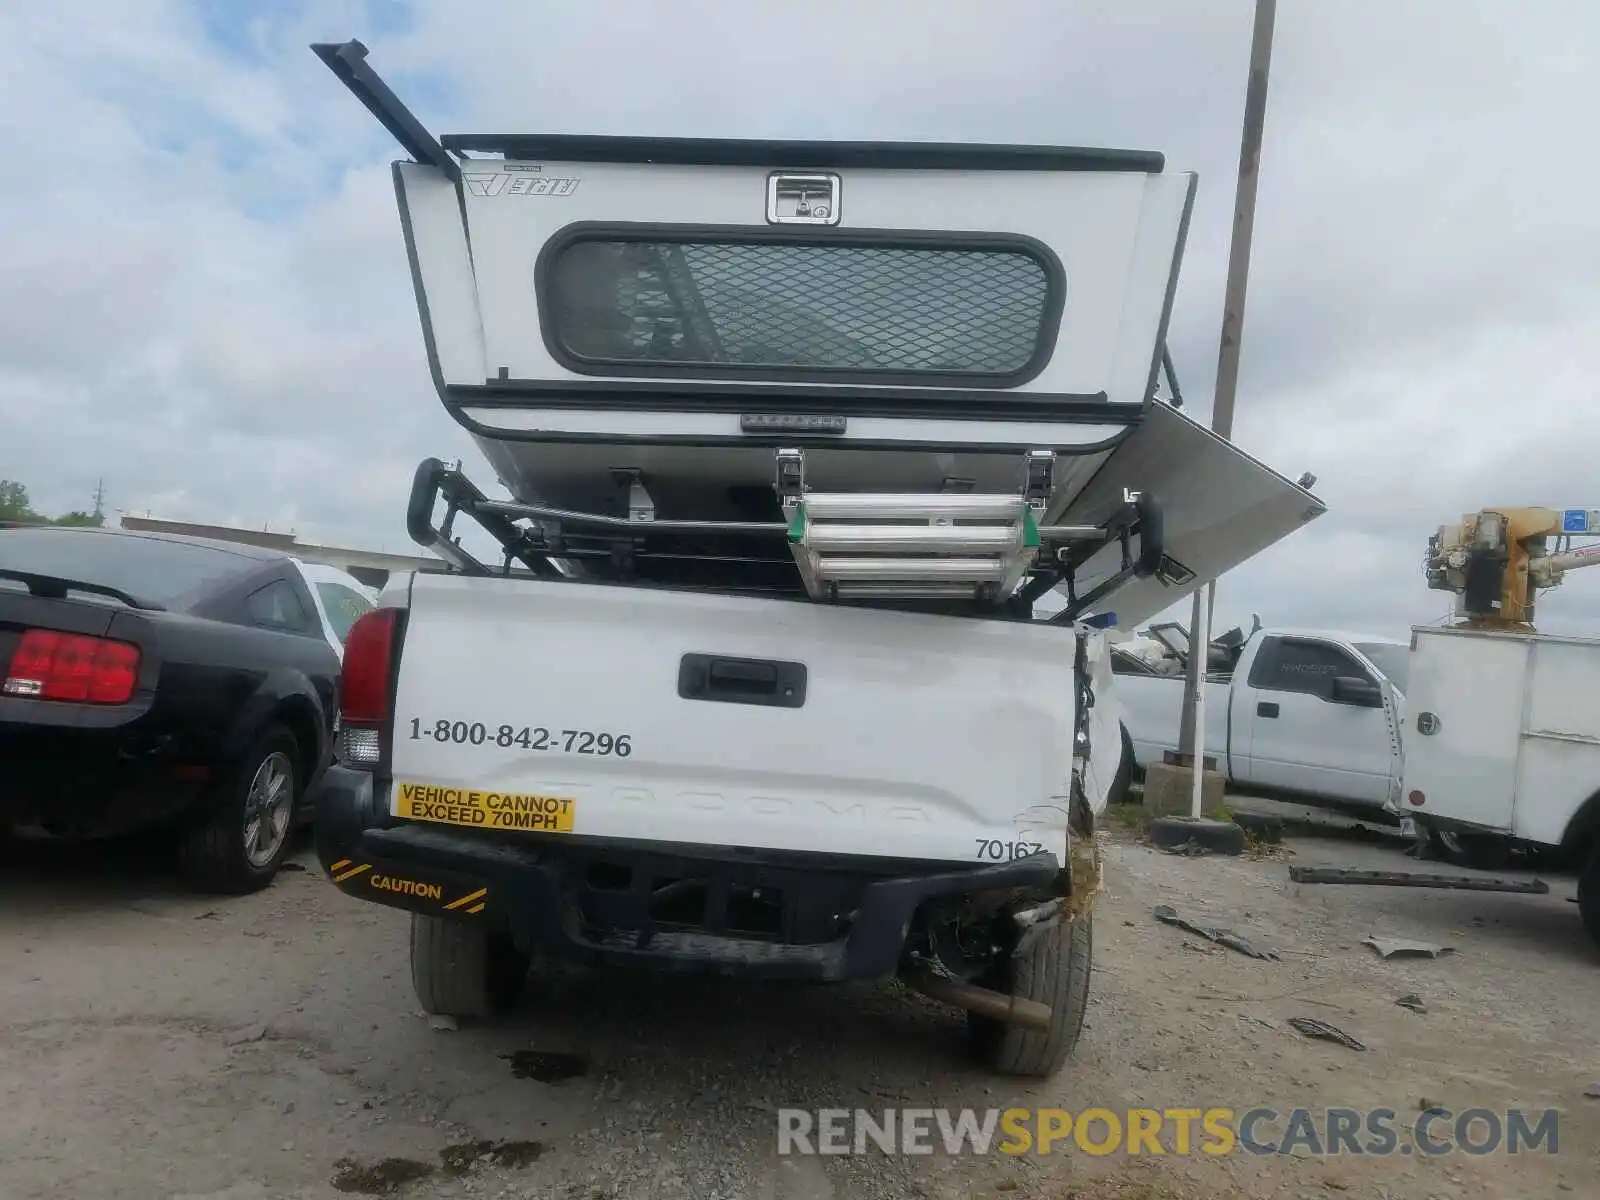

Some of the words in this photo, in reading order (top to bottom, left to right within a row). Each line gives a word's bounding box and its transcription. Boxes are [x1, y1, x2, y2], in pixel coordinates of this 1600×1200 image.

[409, 717, 632, 757] 1-800-842-7296
[402, 784, 481, 808] VEHICLE
[486, 794, 573, 815] CANNOT
[411, 803, 486, 824] EXCEED
[491, 810, 558, 829] 70MPH
[370, 874, 443, 900] CAUTION
